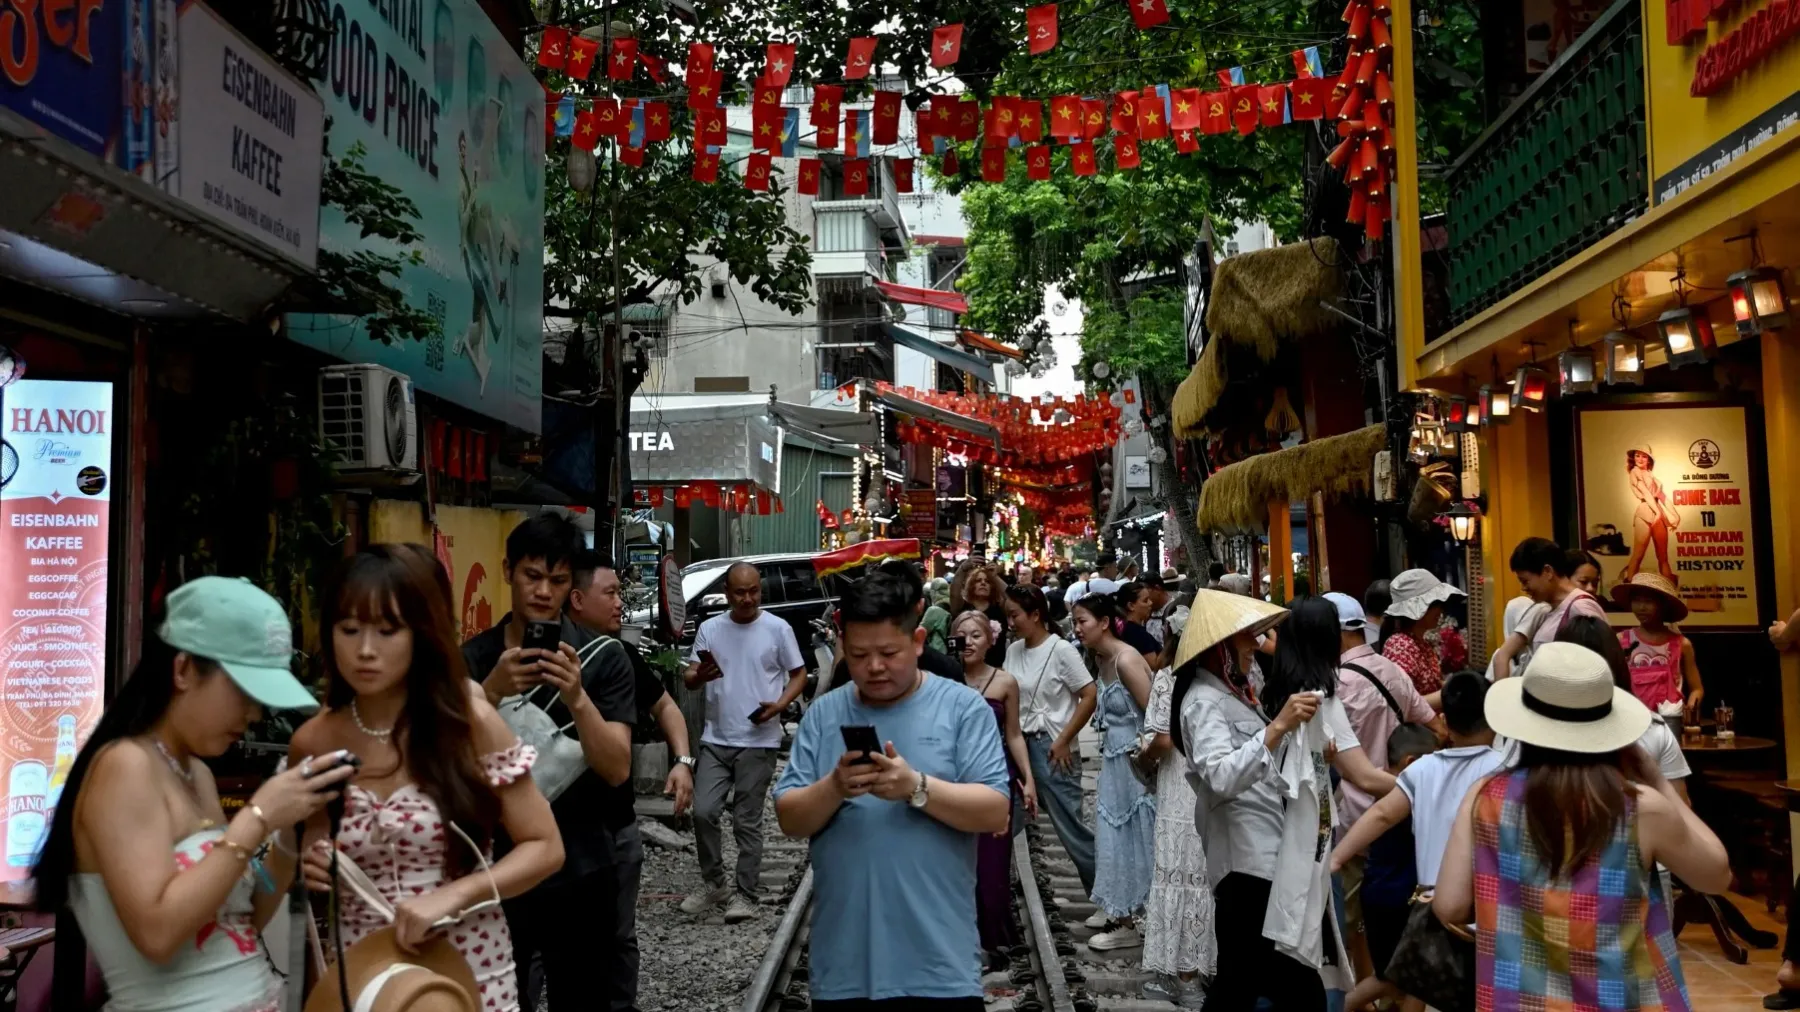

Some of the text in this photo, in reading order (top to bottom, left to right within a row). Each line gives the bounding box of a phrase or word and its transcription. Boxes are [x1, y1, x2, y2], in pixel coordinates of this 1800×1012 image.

[384, 52, 440, 179] PRICE
[231, 125, 283, 197] KAFFEE
[11, 408, 106, 434] HANOI
[34, 438, 82, 459] Premium
[628, 431, 675, 452] TEA
[1672, 488, 1742, 506] COME BACK
[11, 513, 99, 527] EISENBAHN
[1700, 510, 1716, 527] TO
[26, 536, 83, 550] KAFFEE
[1675, 530, 1744, 544] VIETNAM
[1676, 545, 1745, 557] RAILROAD
[31, 557, 46, 566] BIA
[1676, 560, 1745, 571] HISTORY
